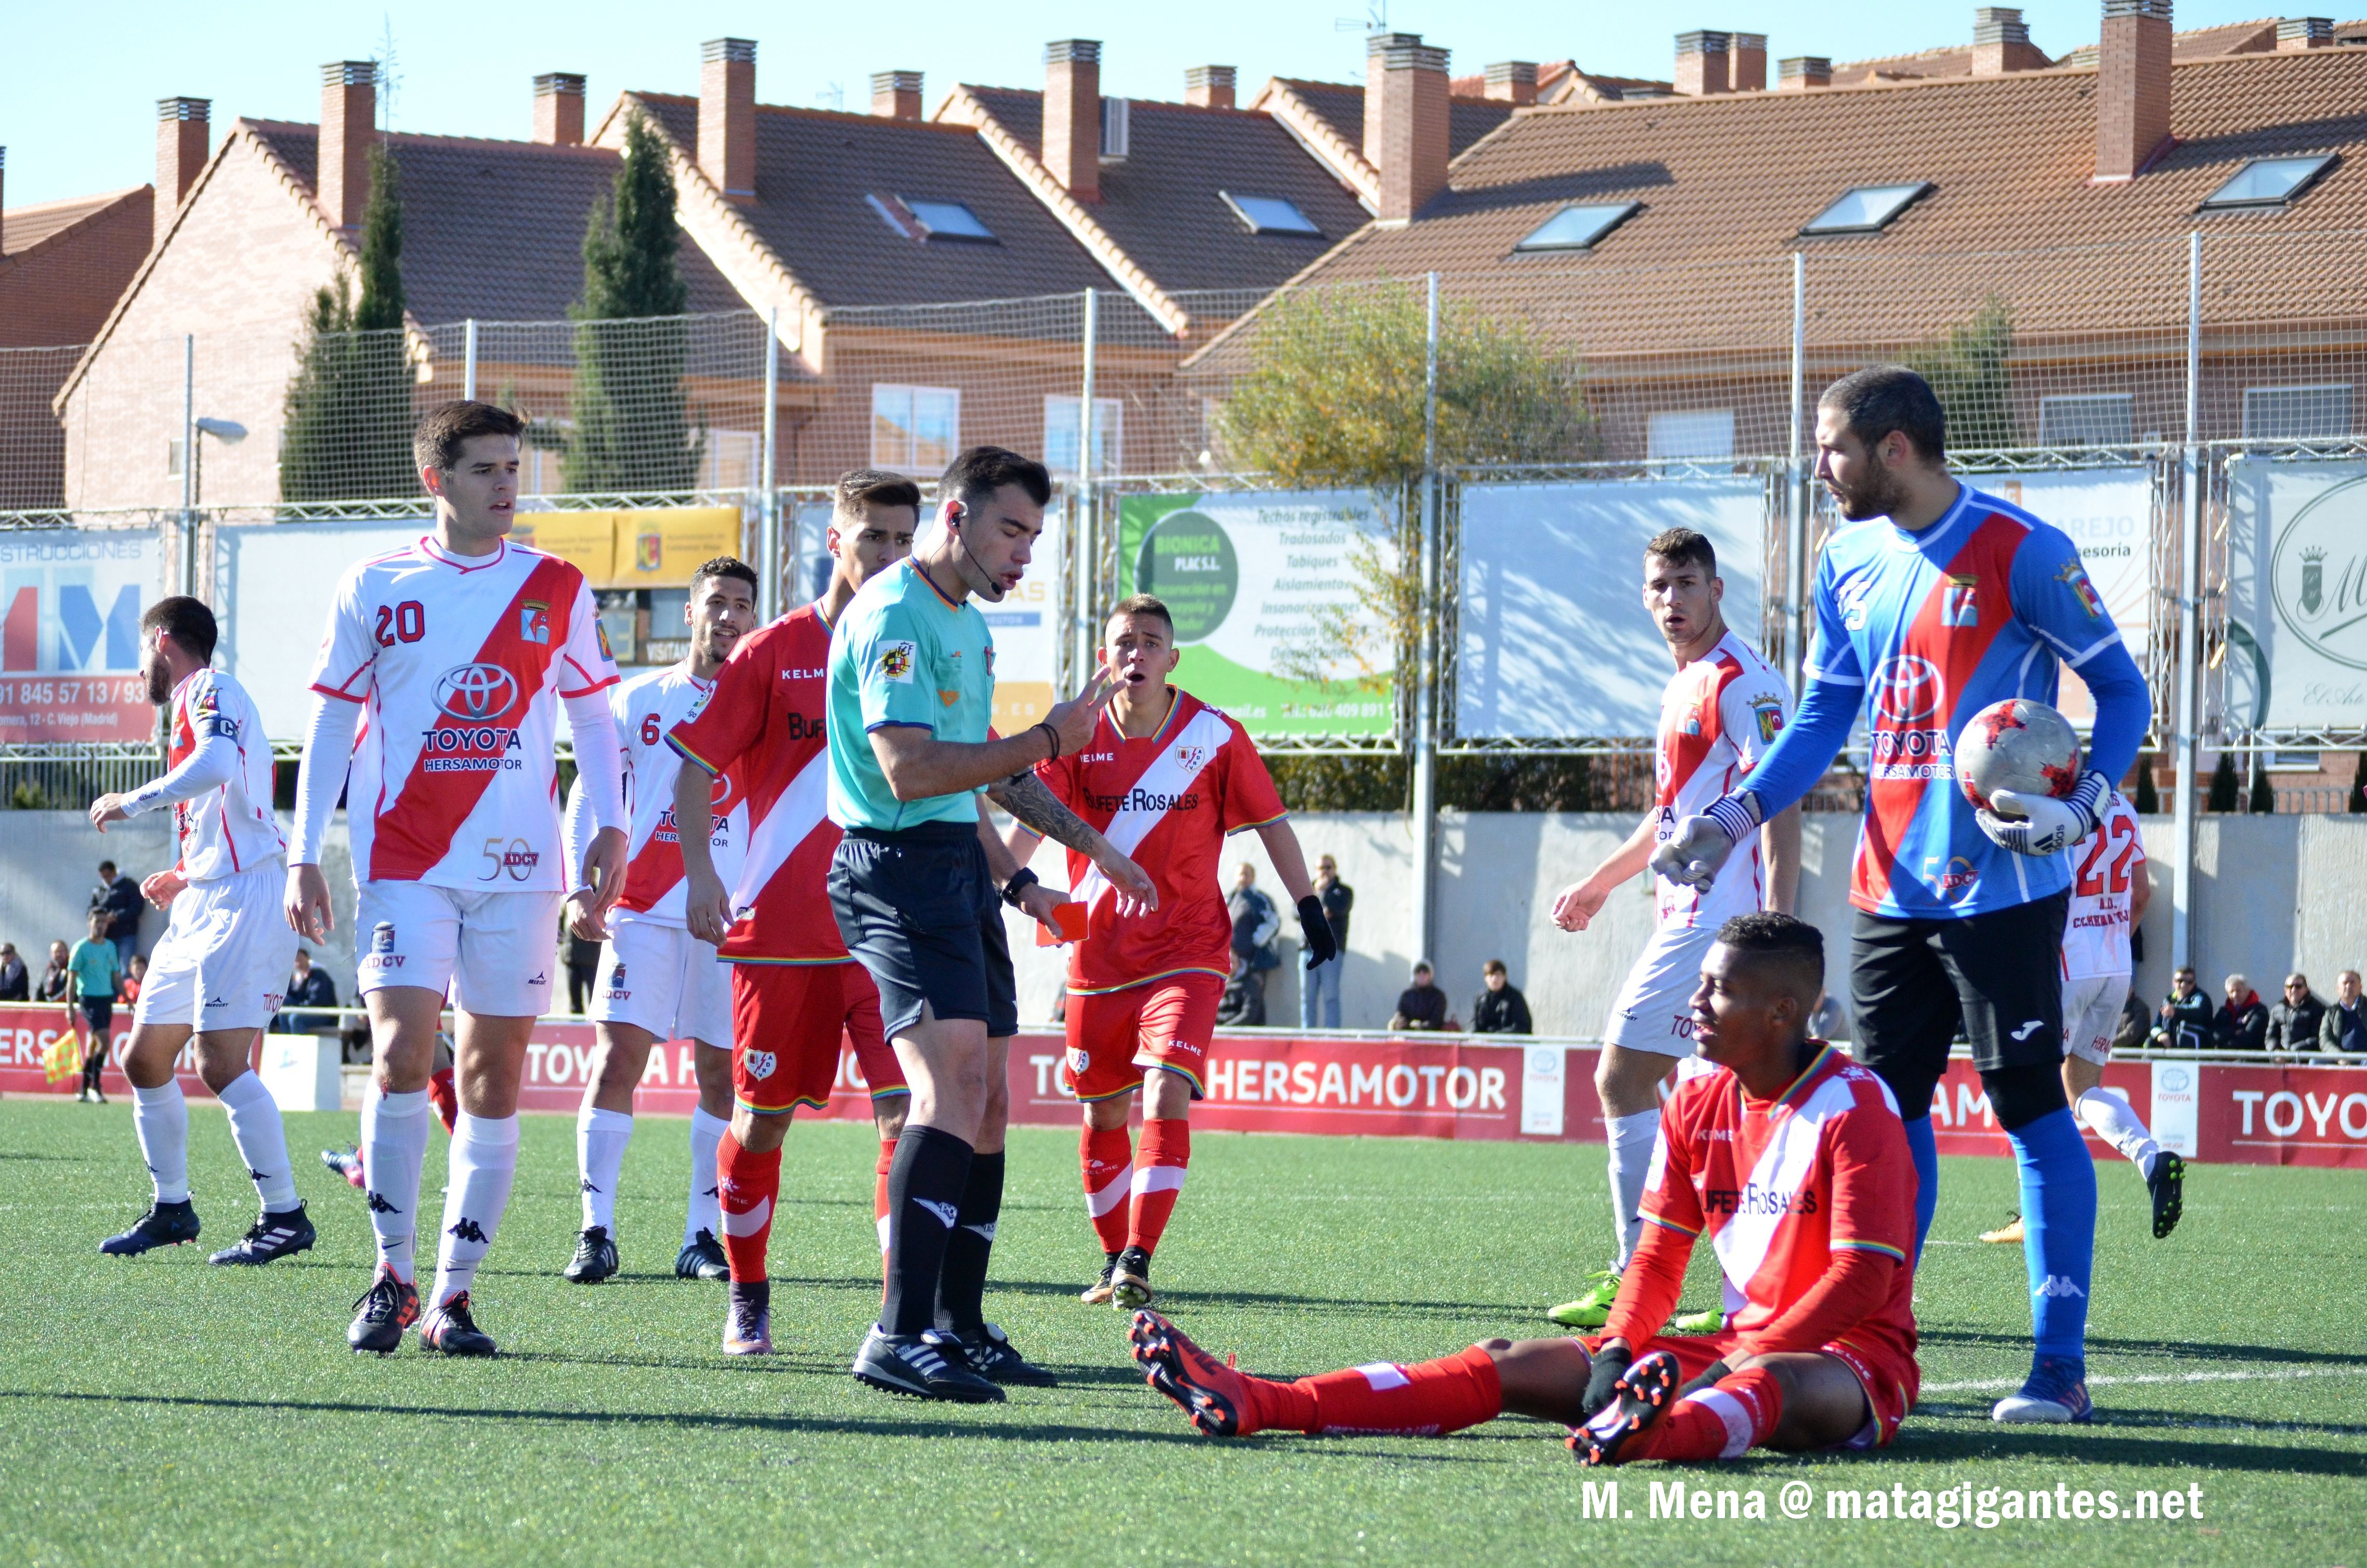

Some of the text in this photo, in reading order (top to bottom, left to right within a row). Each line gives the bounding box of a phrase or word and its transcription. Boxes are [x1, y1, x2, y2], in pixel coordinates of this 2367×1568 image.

[2055, 516, 2135, 538] AREJO
[375, 600, 425, 648] 20
[781, 668, 828, 680] KELM
[21, 683, 53, 704] 845
[59, 683, 81, 703] 57
[87, 682, 108, 703] 13
[30, 712, 41, 725] 12
[1361, 702, 1383, 717] 891
[220, 720, 233, 736] C
[641, 713, 661, 745] 6
[422, 728, 521, 751] TOYOTA
[1871, 729, 1954, 757] TOYOTA
[424, 757, 522, 772] HERSAMOTOR
[477, 837, 531, 882] 50
[502, 852, 540, 867] ADCV
[2073, 814, 2136, 899] 22
[603, 990, 631, 1000] DCV
[1169, 1039, 1202, 1056] KELME
[1205, 1059, 1506, 1112] HERSAMOTOR
[2158, 1093, 2191, 1102] TOYOTA
